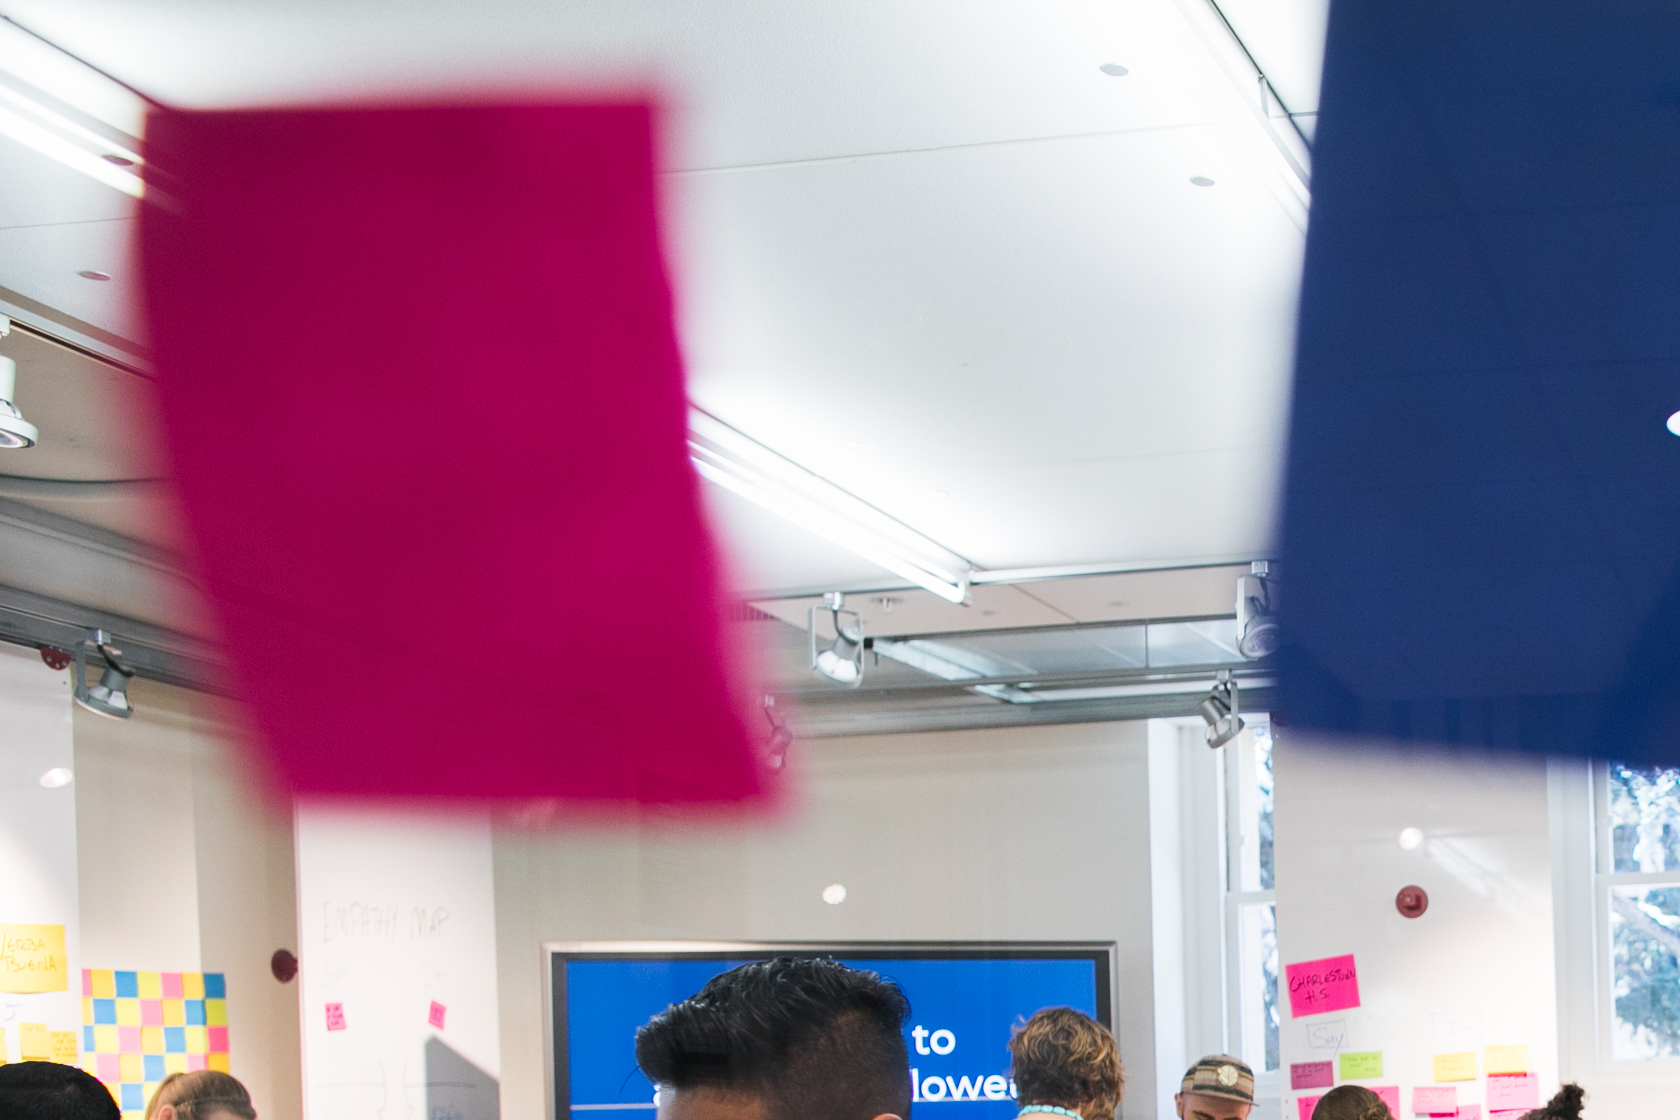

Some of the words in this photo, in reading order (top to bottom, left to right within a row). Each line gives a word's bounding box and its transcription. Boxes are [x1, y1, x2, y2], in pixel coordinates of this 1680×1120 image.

[4, 955, 58, 973] BUENA
[911, 1024, 957, 1056] to
[1312, 1027, 1344, 1058] Say
[911, 1067, 1019, 1103] lowe
